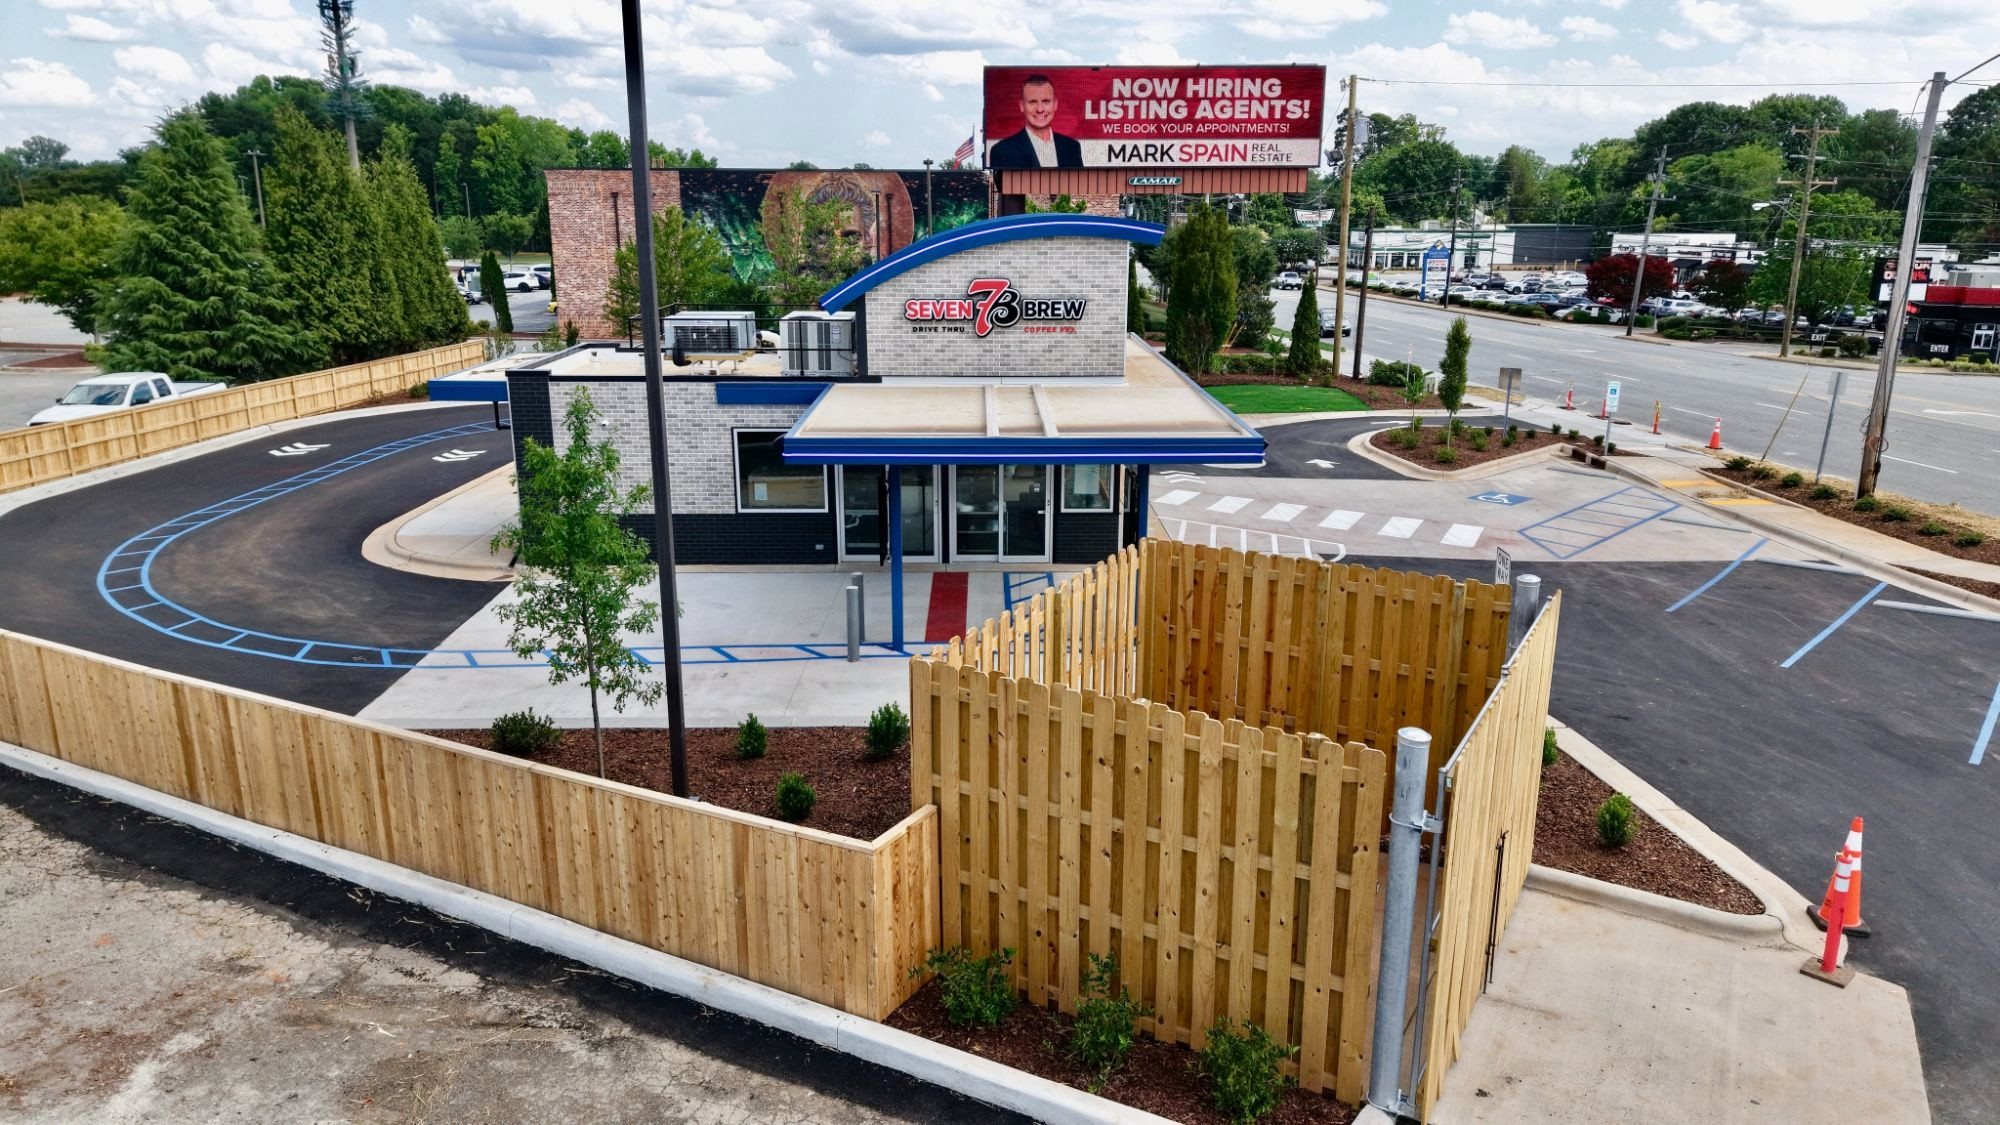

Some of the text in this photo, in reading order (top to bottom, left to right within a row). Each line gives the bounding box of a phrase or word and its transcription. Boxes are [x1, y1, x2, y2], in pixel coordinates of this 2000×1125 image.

[1112, 77, 1282, 98] NOW HIRING
[1085, 99, 1311, 119] LISTING AGENTS!
[1102, 123, 1290, 133] WE BOOK YOUR APPOINTMENTS!
[1107, 143, 1248, 162] MARK SPAIN
[1251, 143, 1281, 152] REAL
[1251, 153, 1293, 162] ESTATE
[1133, 177, 1177, 185] LAMAR
[905, 299, 974, 320] SEVEN
[1023, 299, 1086, 320] BREW
[1811, 333, 1828, 341] EXIT
[1930, 344, 1949, 353] ENTER
[1498, 552, 1510, 570] ONE
